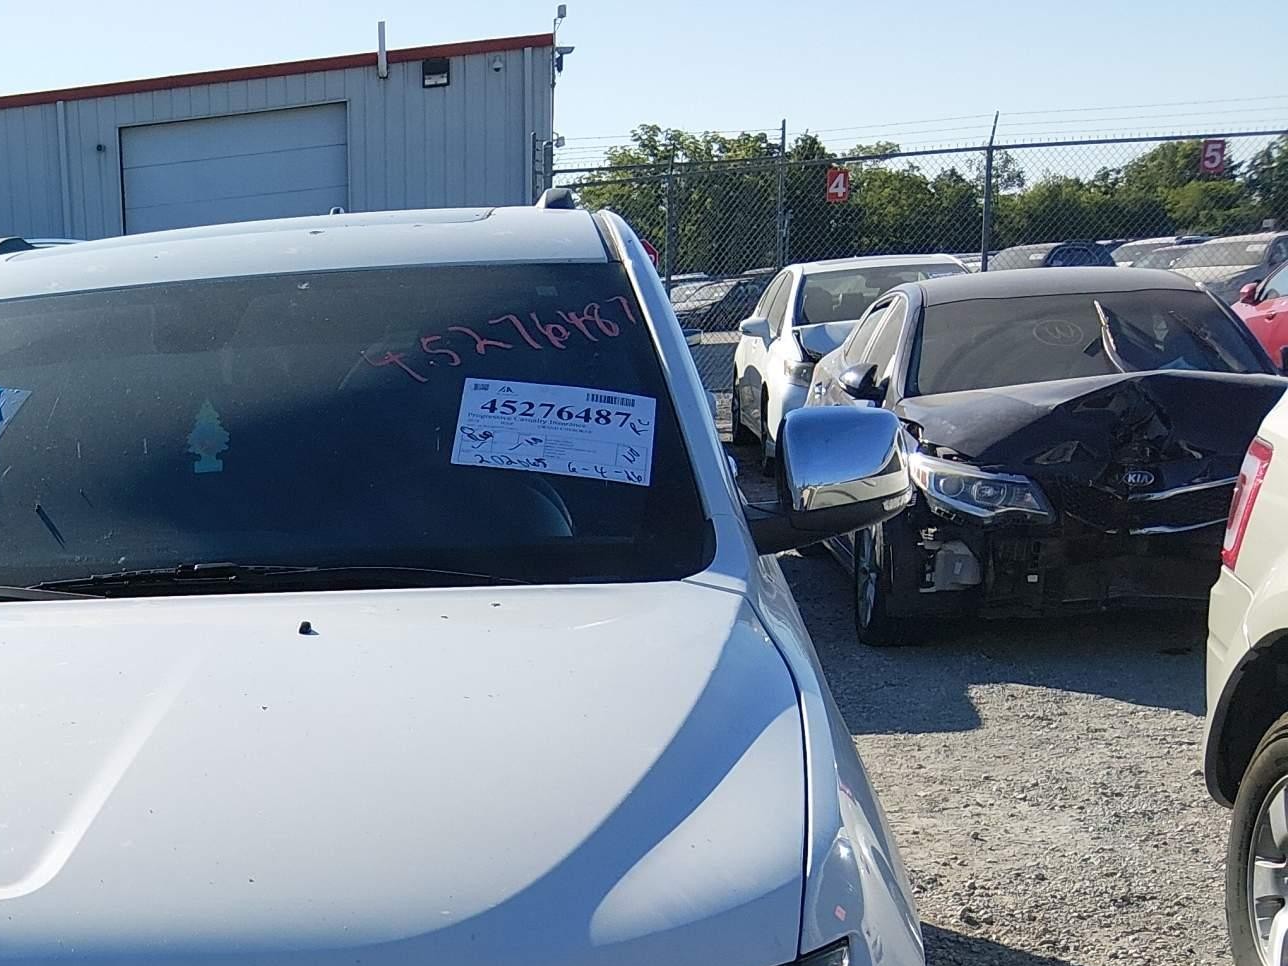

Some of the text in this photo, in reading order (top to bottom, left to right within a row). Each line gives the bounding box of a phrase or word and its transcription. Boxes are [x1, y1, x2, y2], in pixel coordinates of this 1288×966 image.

[1204, 143, 1222, 168] 5
[828, 173, 846, 198] 4
[480, 398, 632, 428] 45276487
[1127, 473, 1149, 483] KIA
